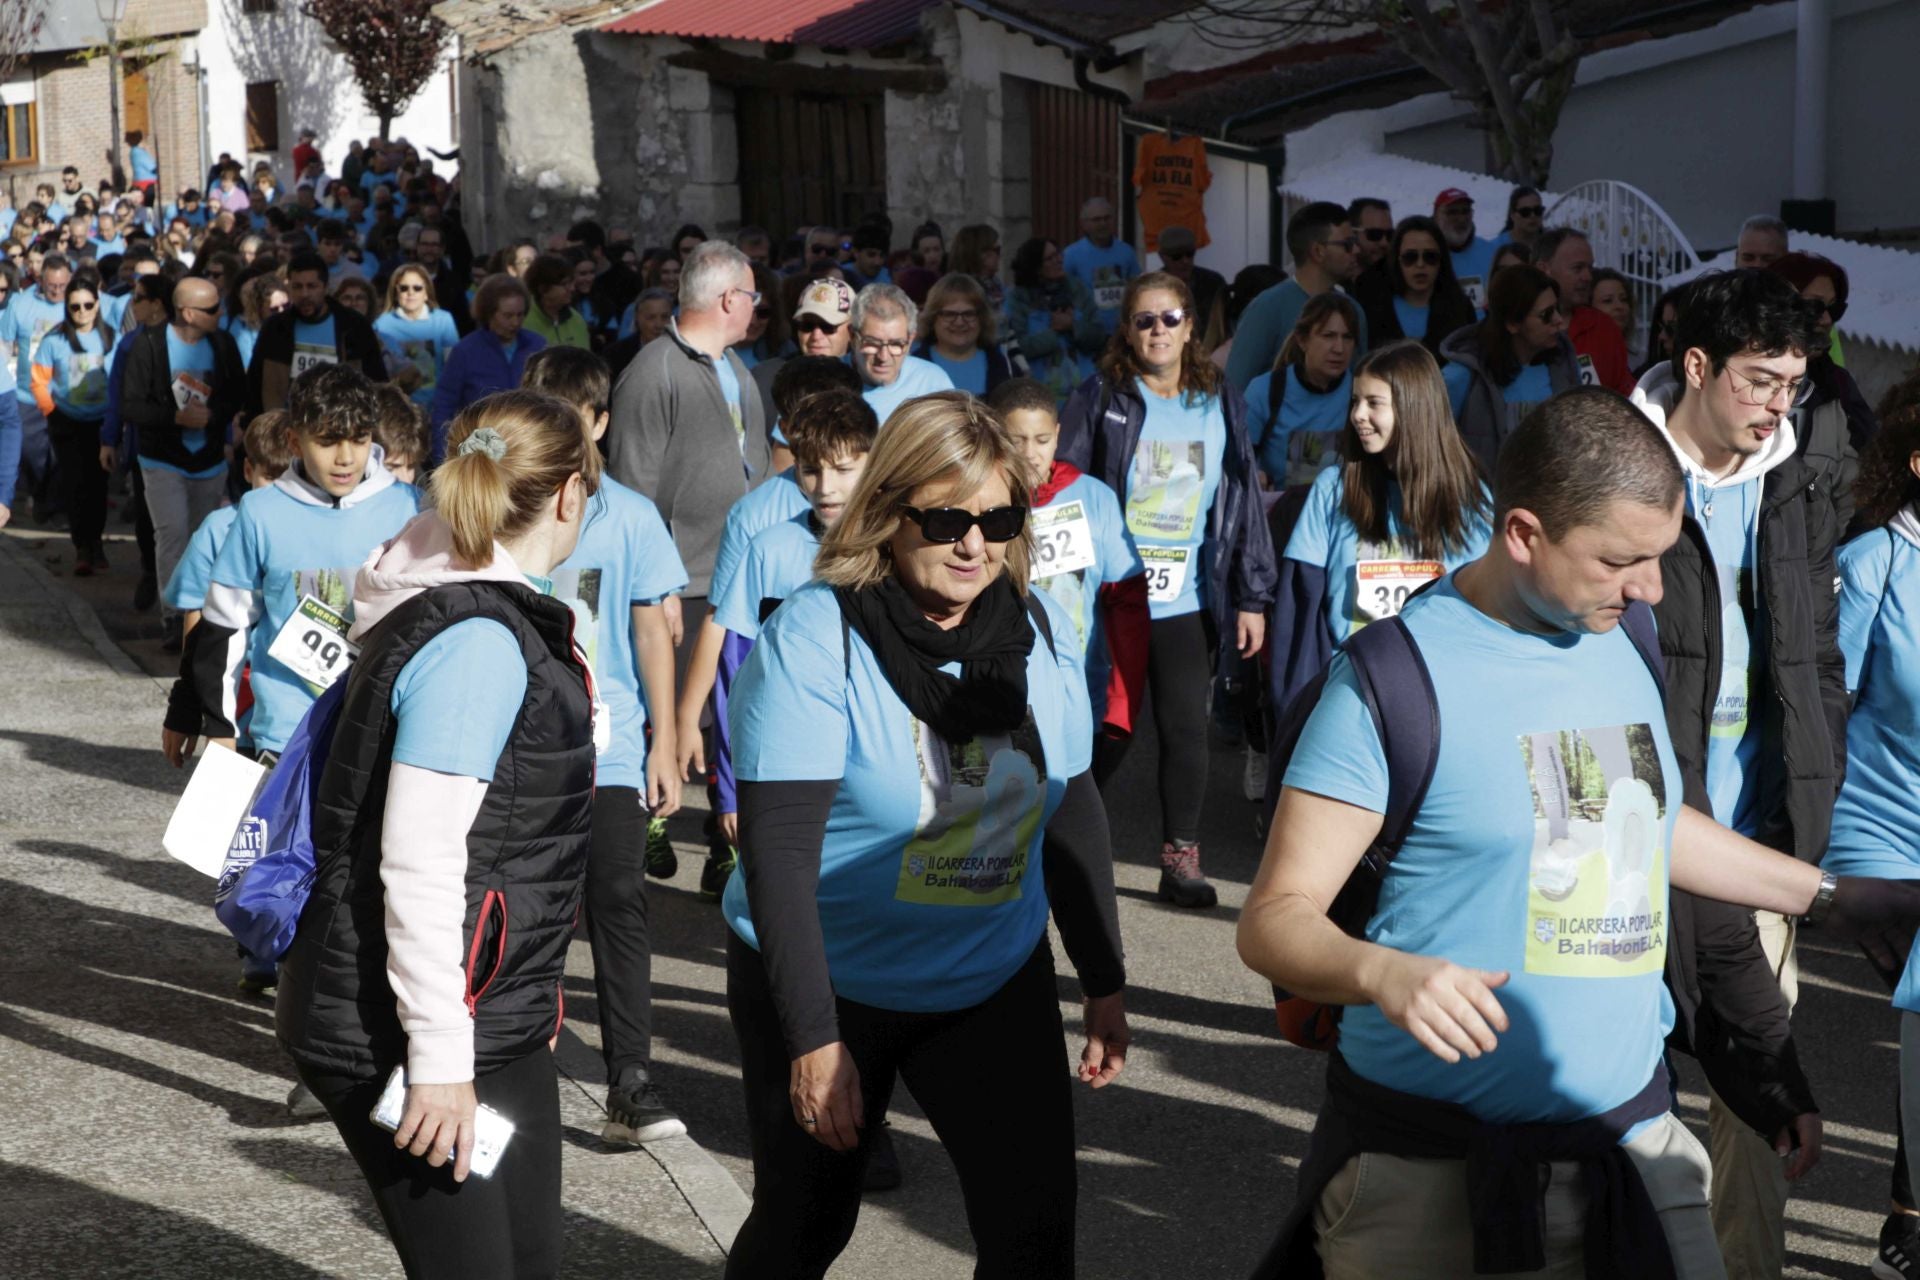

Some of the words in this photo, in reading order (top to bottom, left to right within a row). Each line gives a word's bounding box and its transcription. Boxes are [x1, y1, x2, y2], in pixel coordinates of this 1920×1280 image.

[1154, 155, 1193, 169] CONTRA
[1152, 170, 1167, 184] LA
[936, 854, 985, 870] CARRERA
[987, 852, 1025, 870] POPULAR
[1559, 918, 1567, 934] II
[1569, 916, 1628, 935] CARRERA
[1629, 911, 1662, 934] POPULAR
[1558, 933, 1663, 955] BahabonELA
